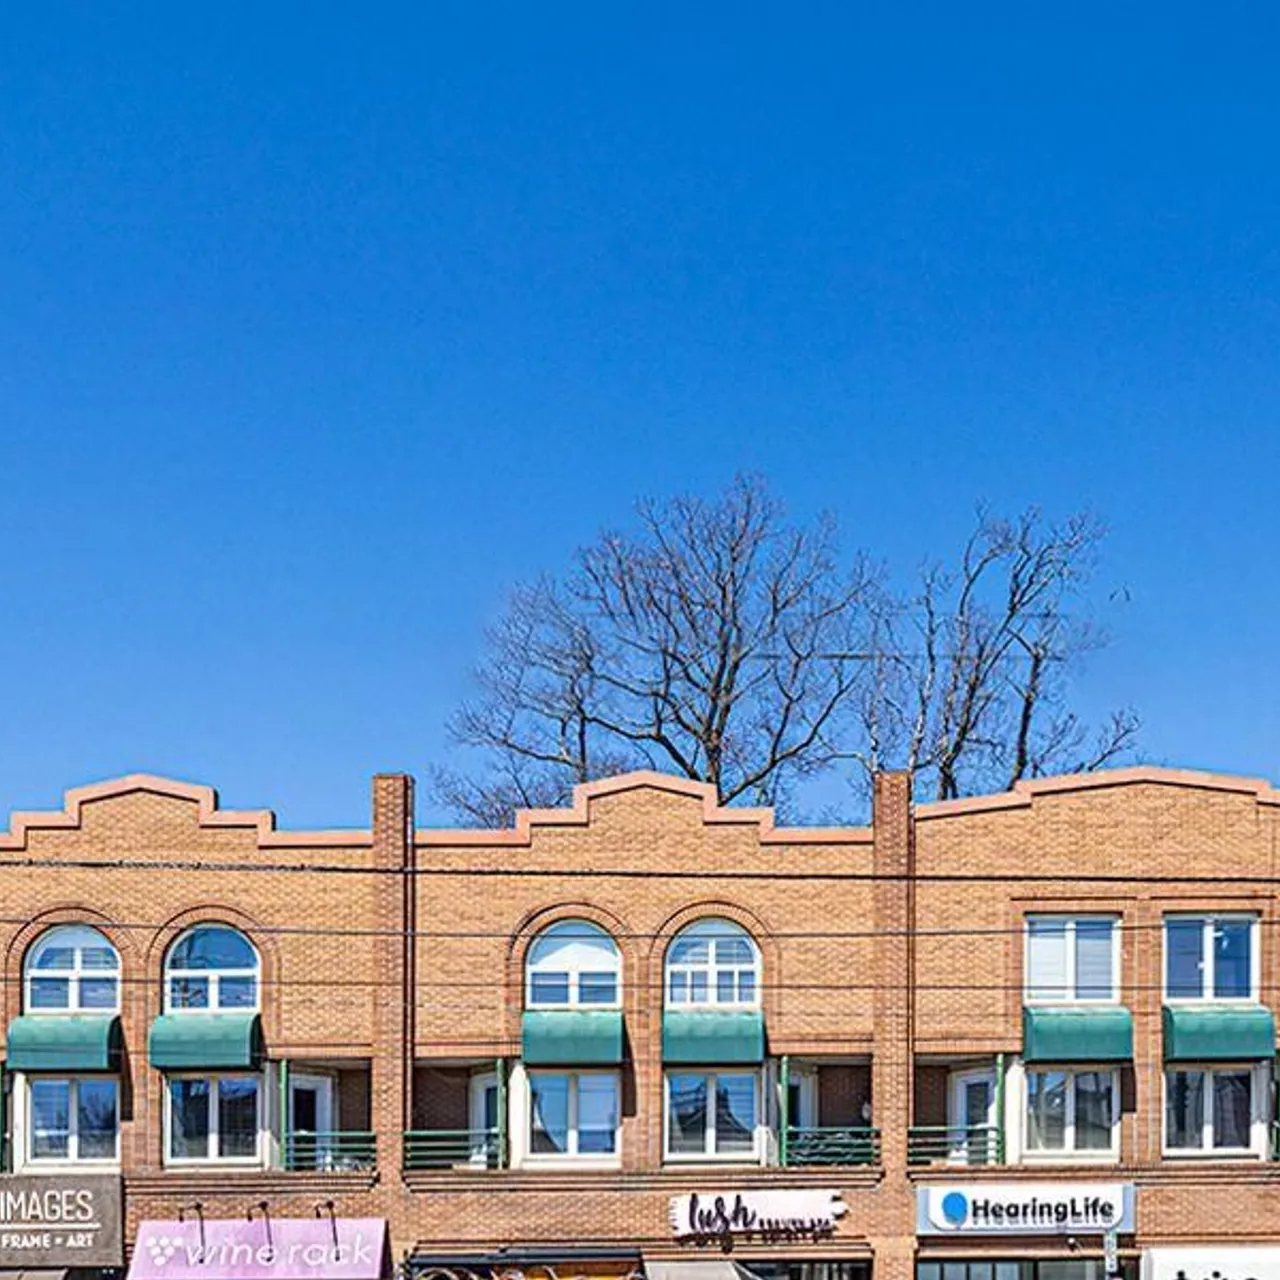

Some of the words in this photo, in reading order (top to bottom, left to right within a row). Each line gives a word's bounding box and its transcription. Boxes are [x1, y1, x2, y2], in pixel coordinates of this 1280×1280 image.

[0, 1190, 93, 1222] IMAGES
[689, 1193, 756, 1232] lush
[972, 1197, 1114, 1222] HearingLife
[1, 1233, 51, 1248] FRAME
[66, 1233, 94, 1248] ART
[187, 1237, 276, 1266] wine
[288, 1233, 371, 1266] rack
